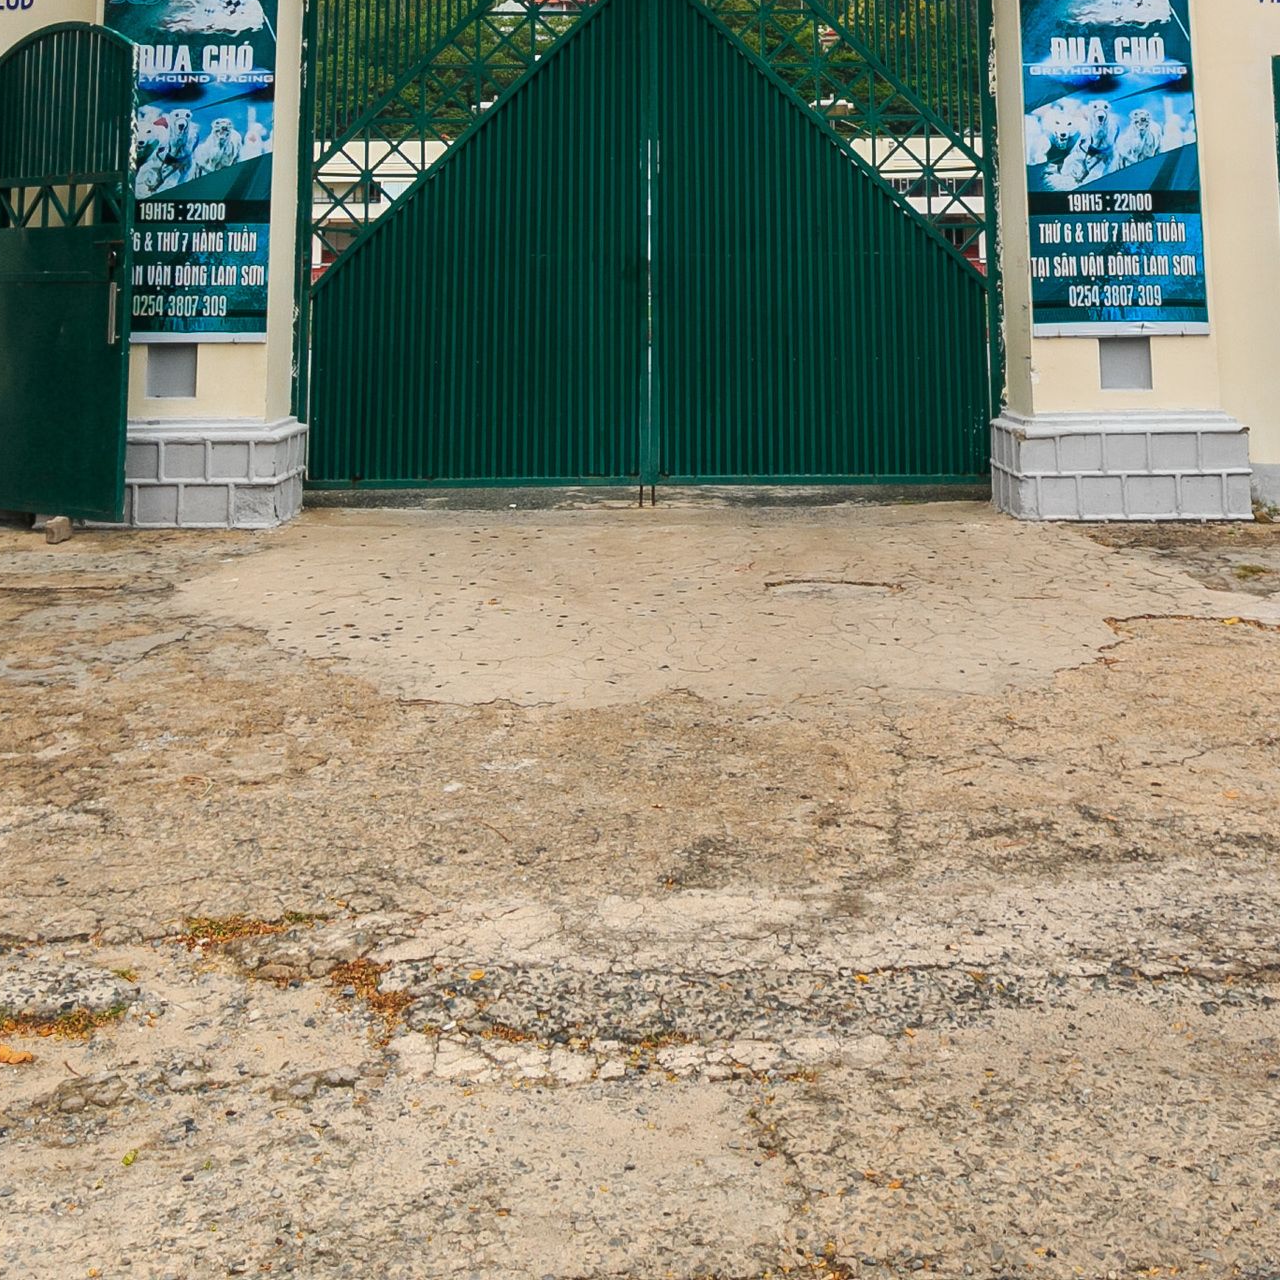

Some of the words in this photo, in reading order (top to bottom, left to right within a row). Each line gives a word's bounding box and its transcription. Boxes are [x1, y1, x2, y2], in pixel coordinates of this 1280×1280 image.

[139, 45, 192, 73] ĐUA
[202, 40, 253, 73] CHÓ
[1050, 37, 1106, 65] ĐUA
[1114, 32, 1166, 65] CHÓ
[140, 203, 175, 220] 19H15
[186, 203, 226, 220] 22h00
[1068, 194, 1102, 211] 19H15
[1114, 193, 1152, 211] 22h00
[133, 231, 141, 252] 6
[144, 232, 153, 252] &
[157, 228, 180, 252] THỨ
[182, 232, 189, 252] 7
[192, 228, 224, 252] HÀNG
[1039, 220, 1061, 243] THỨ
[1064, 223, 1071, 243] 6
[1075, 222, 1084, 243] &
[1087, 219, 1109, 242] THỨ
[1111, 223, 1118, 242] 7
[1122, 219, 1153, 242] HÀNG
[147, 262, 171, 290] VẬN
[175, 262, 207, 290] ĐỘNG
[211, 265, 237, 286] LAM
[241, 264, 265, 286] SƠN
[1031, 257, 1050, 282] TẠI
[1054, 252, 1077, 277] SÂN
[1081, 252, 1104, 281] VẬN
[1108, 252, 1139, 281] ĐỘNG
[1144, 256, 1169, 276] LAM
[1173, 255, 1196, 276] SƠN
[133, 295, 163, 316] 0254
[168, 295, 199, 316] 3807
[203, 295, 227, 316] 309
[1069, 286, 1099, 306] 0254
[1104, 286, 1134, 306] 3807
[1138, 285, 1163, 306] 309
